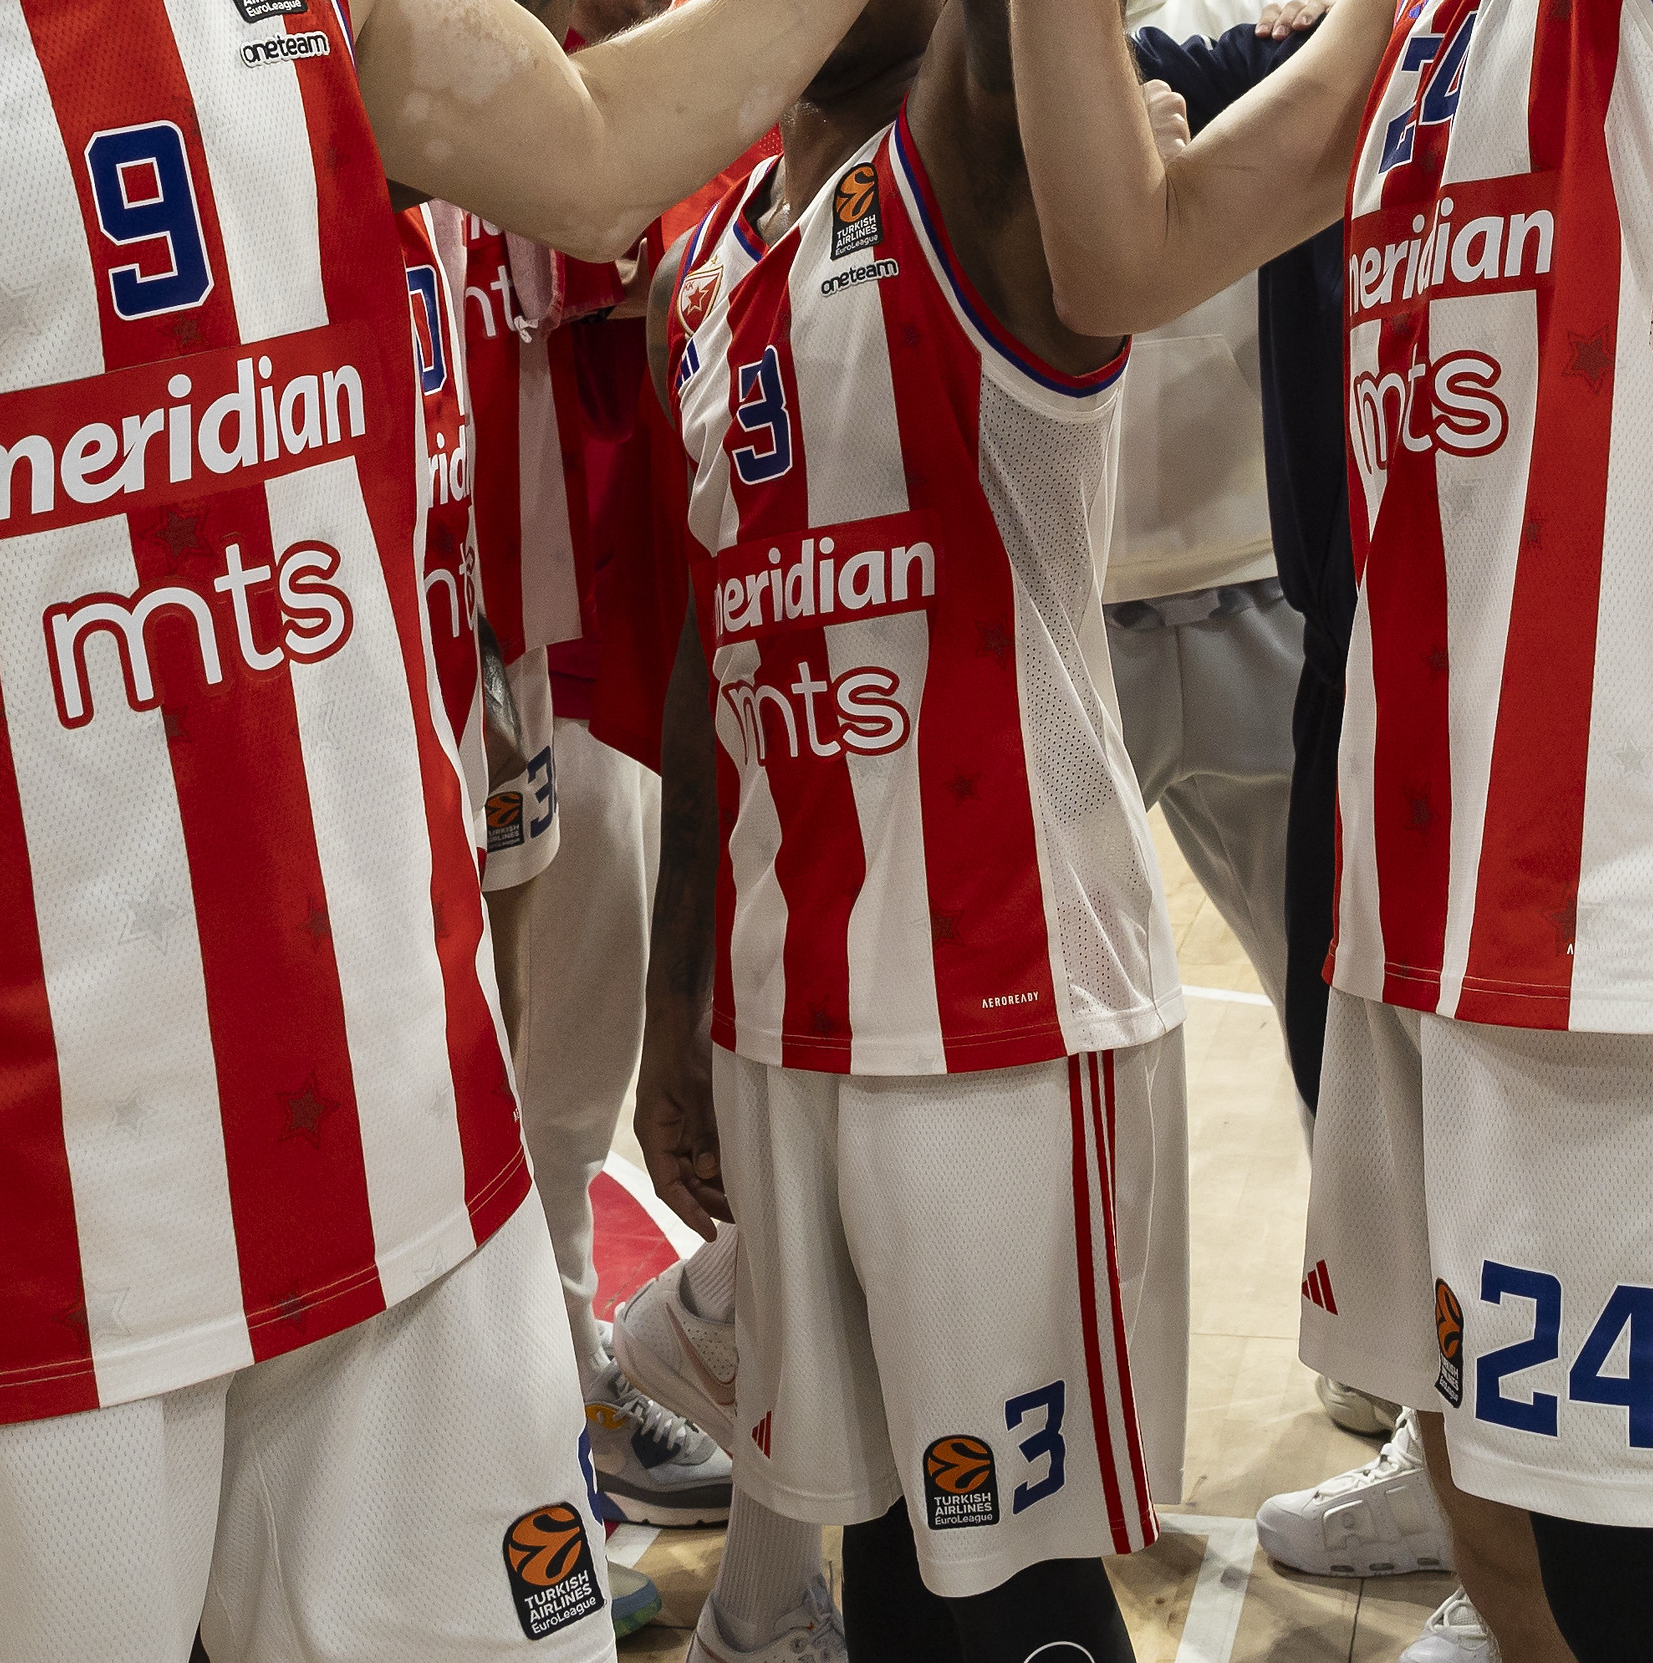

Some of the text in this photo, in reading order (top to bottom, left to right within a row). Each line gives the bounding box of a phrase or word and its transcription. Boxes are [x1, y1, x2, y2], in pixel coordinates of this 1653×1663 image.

[84, 120, 215, 322] 9
[835, 223, 878, 249] AIRLINES
[836, 213, 877, 239] TURKISH
[50, 541, 347, 719] mts
[728, 660, 905, 762] mts
[981, 989, 1040, 1009] AEROREADY
[1003, 1379, 1066, 1515] 3
[933, 1491, 992, 1506] TURKISH
[935, 1502, 993, 1516] AIRLINES
[934, 1513, 994, 1526] EuroLeague
[524, 1569, 590, 1610] TURKISH
[529, 1582, 593, 1624] AIRLINES
[530, 1596, 597, 1635] EuroLeague
